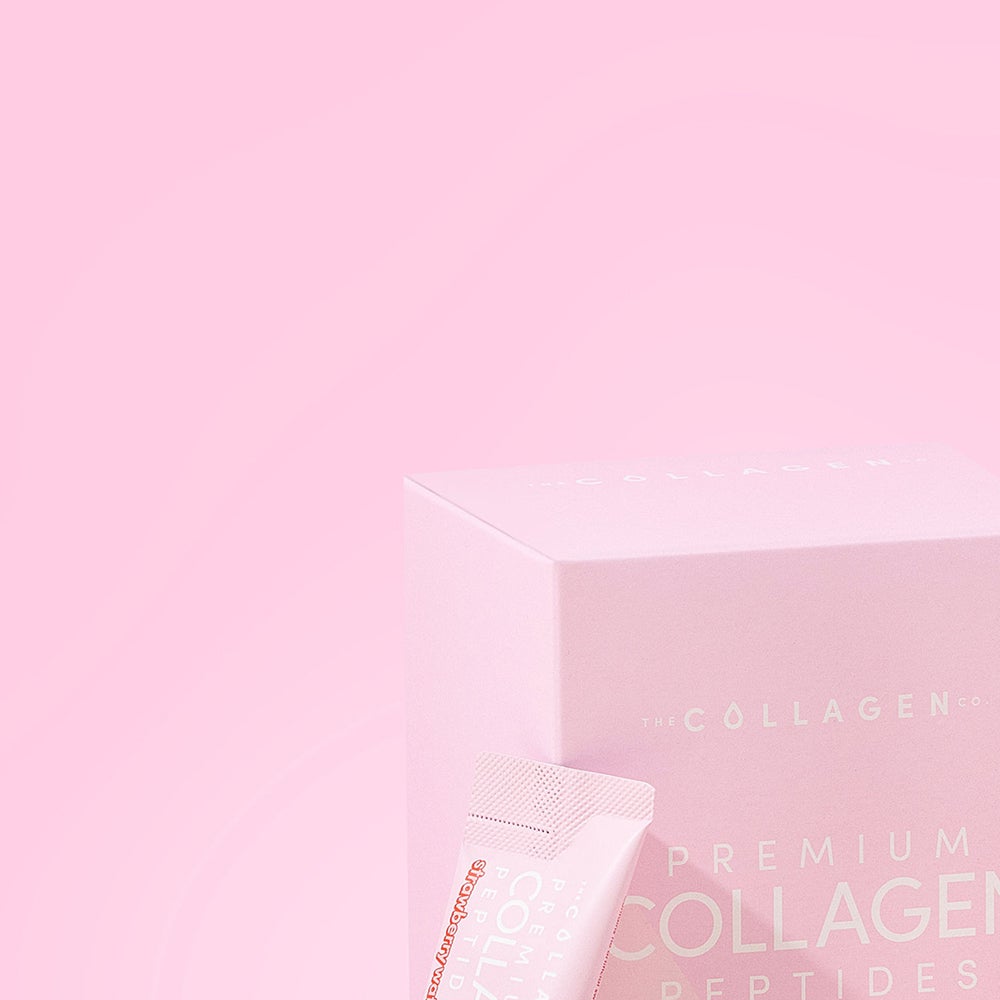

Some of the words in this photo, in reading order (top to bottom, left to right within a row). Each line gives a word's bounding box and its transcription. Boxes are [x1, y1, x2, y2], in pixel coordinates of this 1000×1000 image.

[574, 458, 893, 487] COLLAGEN
[641, 716, 676, 728] THE
[683, 691, 949, 733] COLLAGEN
[958, 696, 989, 708] CO.
[667, 826, 970, 877] PREMIUM
[435, 859, 487, 968] strawberry
